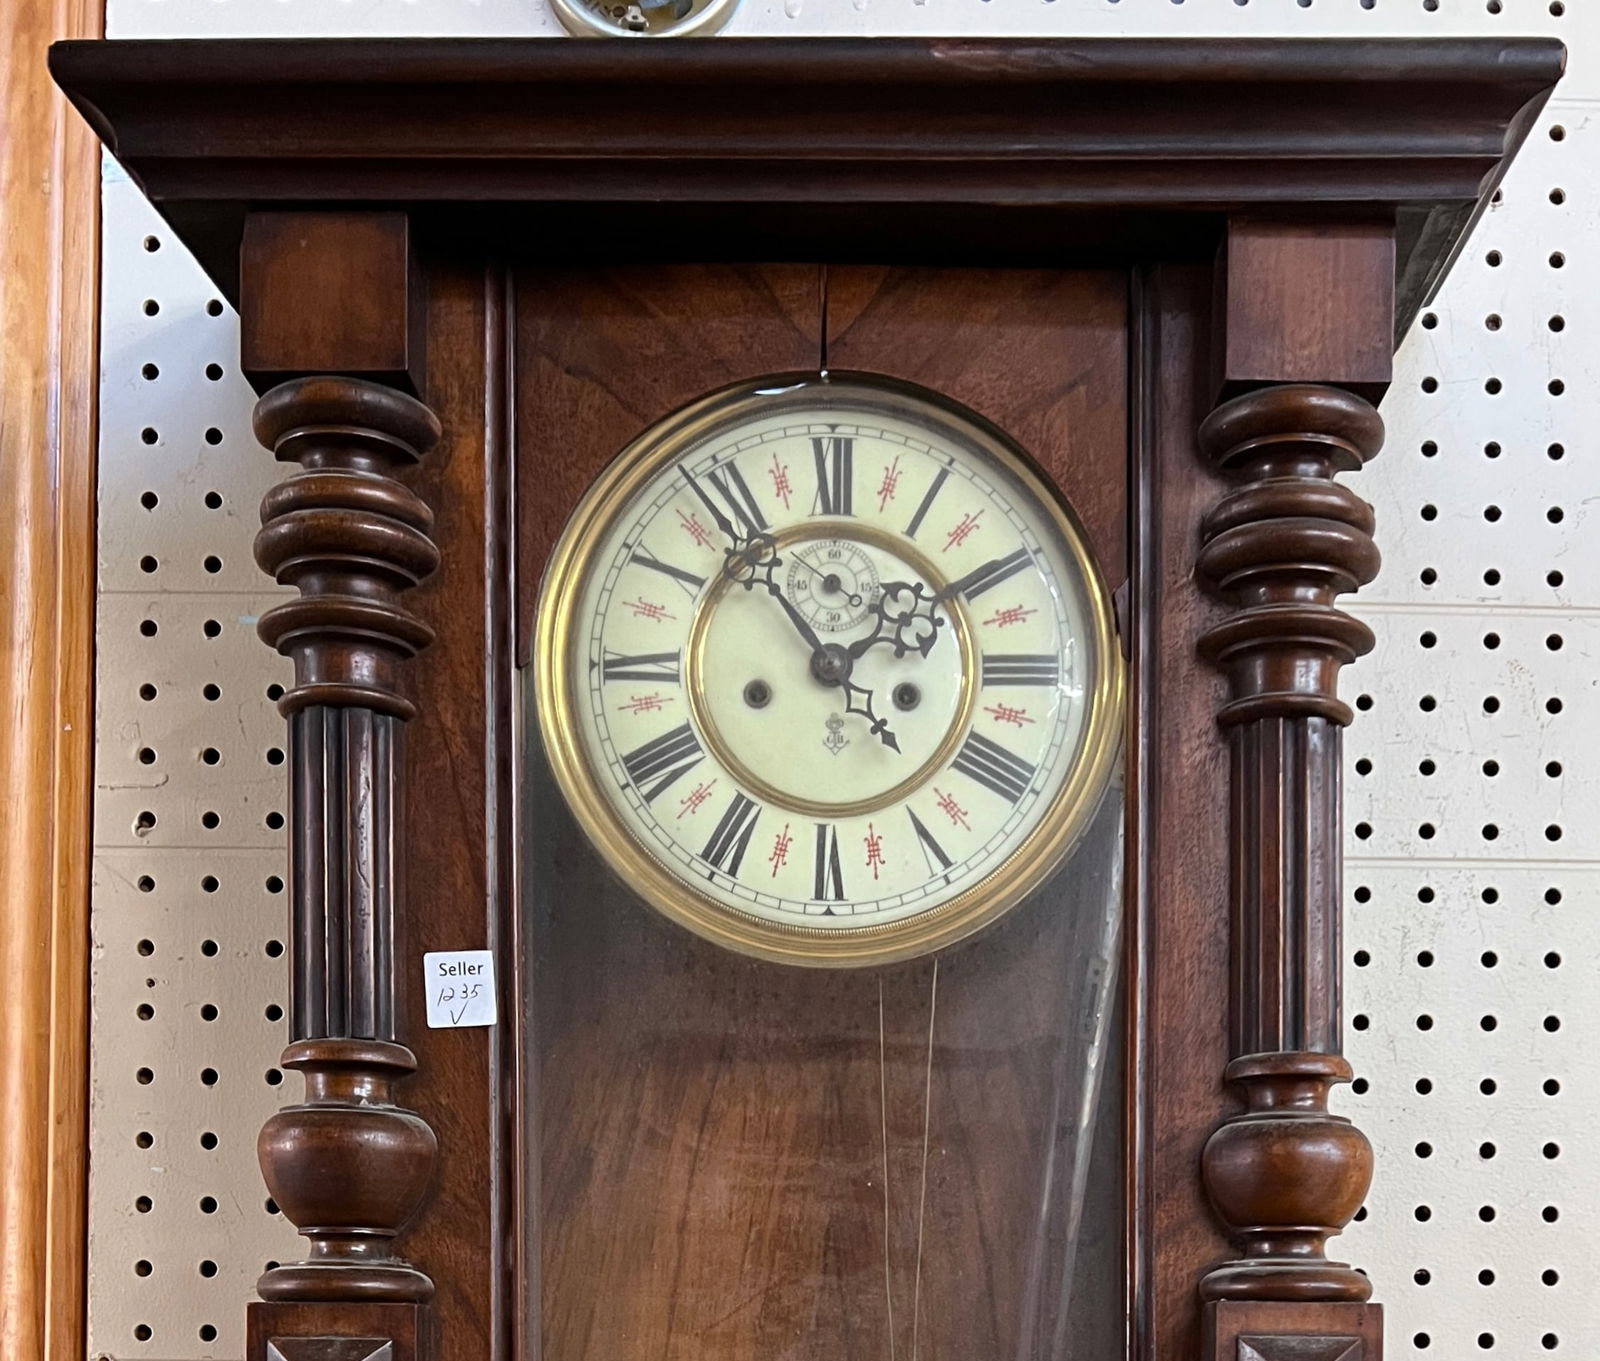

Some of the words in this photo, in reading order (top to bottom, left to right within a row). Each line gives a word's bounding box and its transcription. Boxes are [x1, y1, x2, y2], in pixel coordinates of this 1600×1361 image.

[809, 437, 857, 517] XII
[901, 463, 954, 541] I
[627, 540, 708, 602] X
[828, 548, 842, 559] 60
[861, 583, 872, 593] 15
[826, 612, 841, 623] 30
[603, 646, 681, 688] IX
[981, 650, 1059, 692] III
[621, 718, 706, 803] VIII
[697, 789, 762, 879] VII
[906, 804, 958, 878] V
[810, 823, 849, 901] VI
[437, 983, 483, 1007] 1235
[439, 961, 484, 977] Seller
